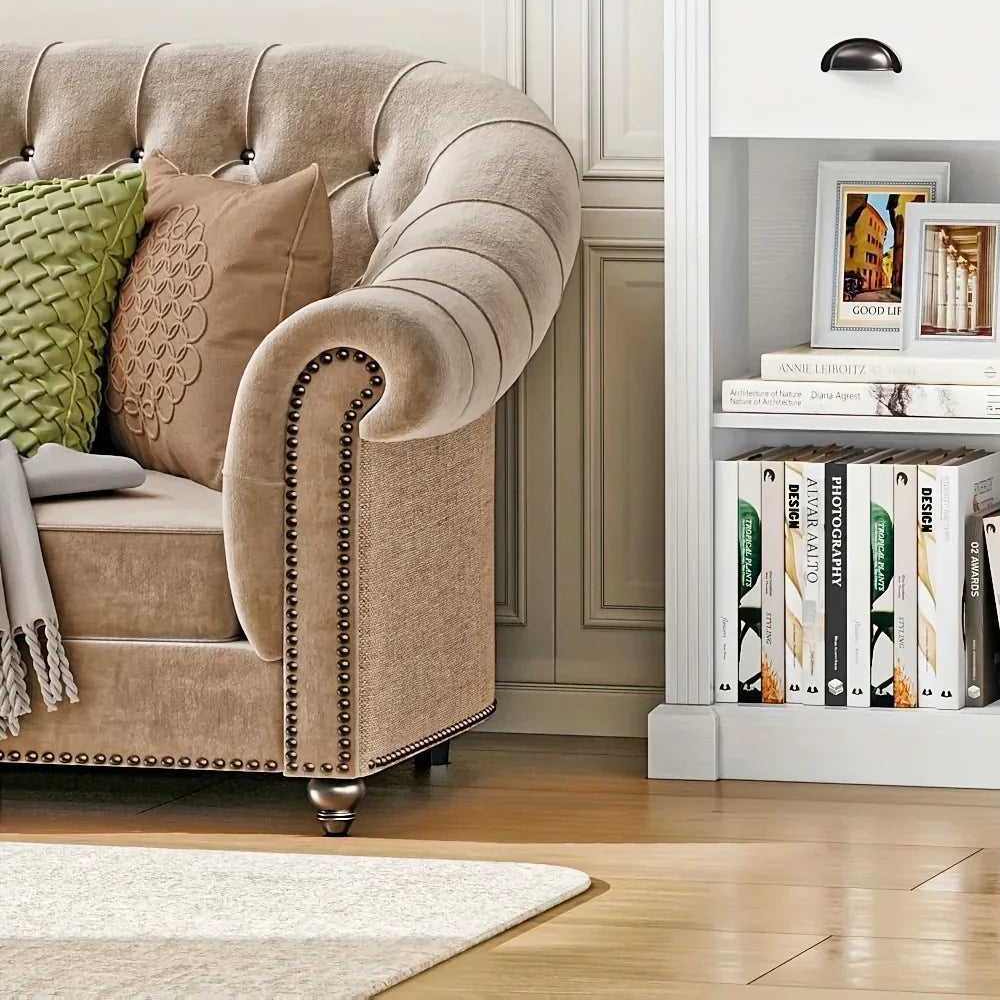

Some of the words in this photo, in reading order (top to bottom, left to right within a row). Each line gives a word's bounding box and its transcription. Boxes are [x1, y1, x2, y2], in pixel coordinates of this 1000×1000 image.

[852, 306, 885, 315] GOOD
[780, 363, 811, 373] ANNIE
[811, 390, 833, 399] Diana
[836, 391, 860, 401] Agrest
[788, 484, 799, 528] DESIGN
[806, 478, 818, 528] ALVAR
[922, 488, 933, 532] DESIGN
[831, 476, 841, 587] PHOTOGRAPHY
[806, 531, 818, 584] AALTO
[970, 555, 979, 597] AWARDS
